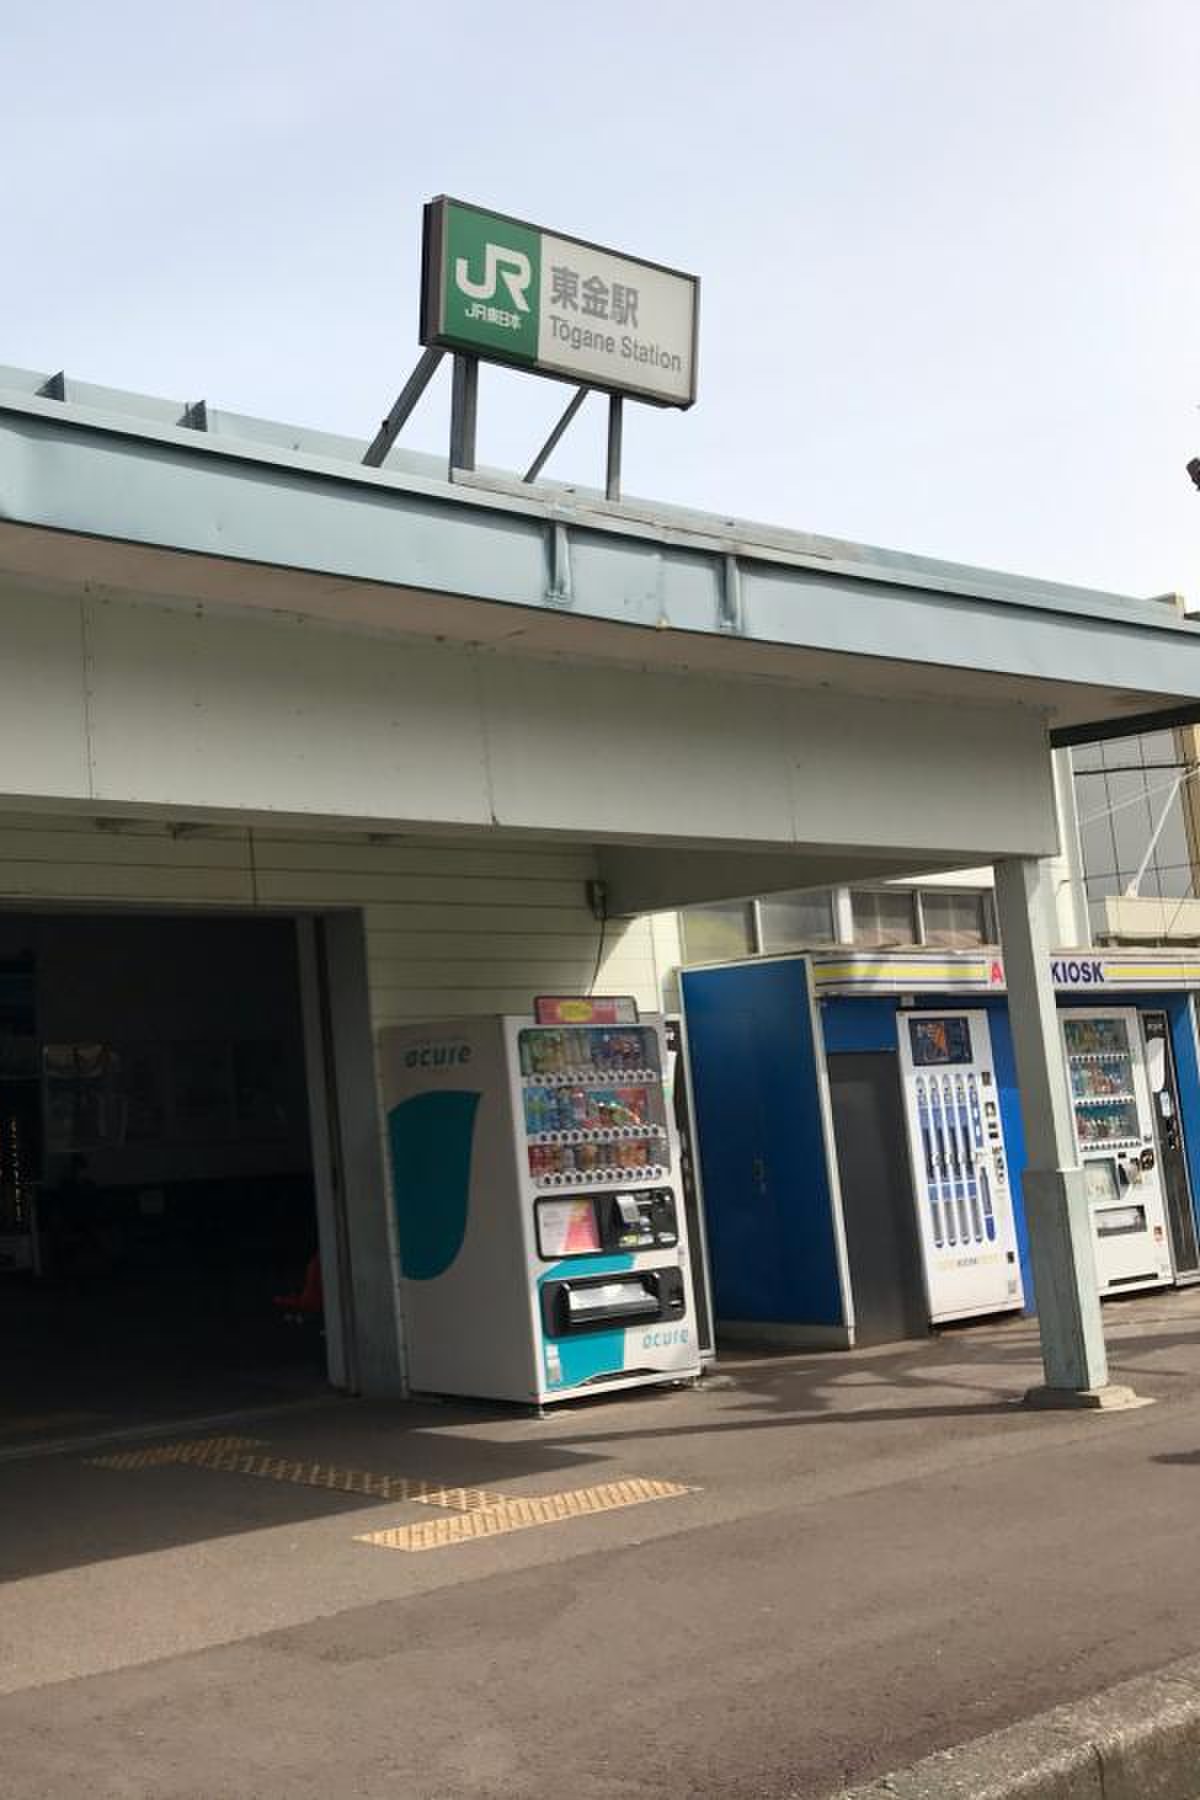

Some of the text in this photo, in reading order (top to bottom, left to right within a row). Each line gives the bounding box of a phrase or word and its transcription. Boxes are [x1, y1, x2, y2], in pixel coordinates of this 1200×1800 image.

[456, 242, 531, 313] JR
[550, 265, 640, 329] 東金駅
[621, 335, 682, 373] Station
[1051, 961, 1105, 984] KIOSK
[405, 1043, 471, 1069] acure
[643, 1328, 689, 1348] acure
